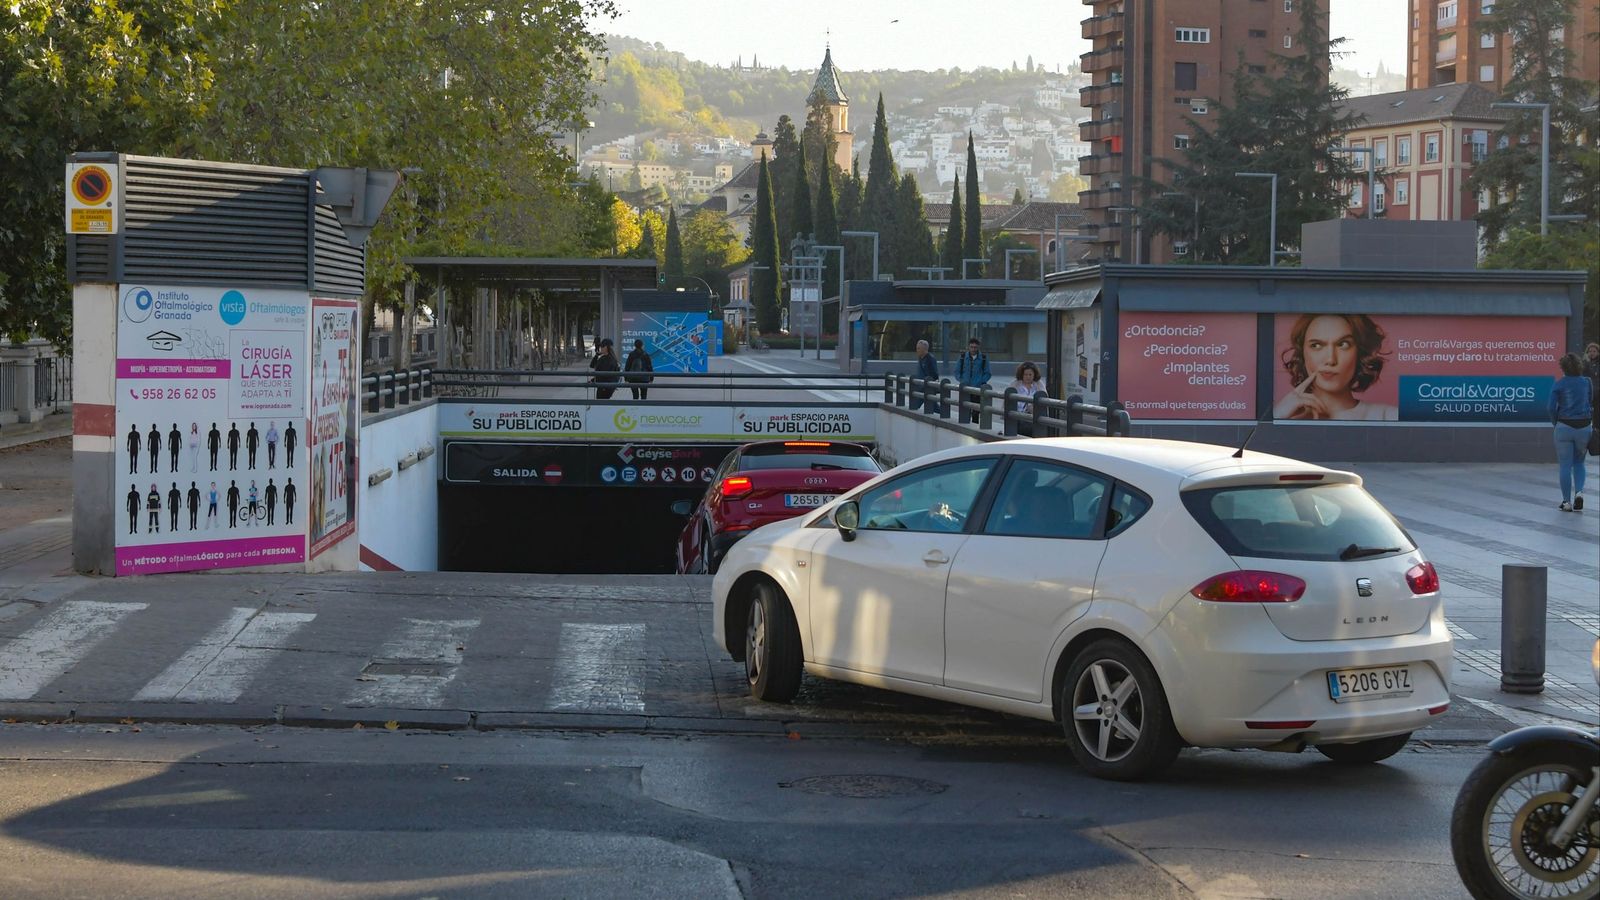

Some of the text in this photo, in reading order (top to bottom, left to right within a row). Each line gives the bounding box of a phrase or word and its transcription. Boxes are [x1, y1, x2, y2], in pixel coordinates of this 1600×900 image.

[157, 291, 189, 300] Instituto
[154, 300, 213, 312] Oftalmológico
[222, 301, 244, 312] vista
[250, 302, 306, 316] Oftalmólogos
[154, 311, 192, 320] Granada
[1125, 325, 1205, 338] ¿Ortodoncia?
[1144, 344, 1228, 357] ¿Periodoncia?
[1398, 340, 1555, 350] En Corral&Vargas queremos que
[242, 345, 292, 359] CIRUGÍA
[1398, 353, 1431, 363] tengas
[1432, 354, 1454, 363] muy
[1457, 353, 1482, 361] claro
[1496, 353, 1555, 362] tratamiento.
[130, 364, 145, 373] MIOPÍA
[241, 360, 292, 379] LÁSER
[1164, 362, 1230, 375] ¿Implantes
[1188, 374, 1247, 385] dentales?
[142, 388, 216, 399] 958 26 62 05
[241, 390, 273, 398] ADAPTA
[1418, 383, 1535, 401] Corral&Vargas
[1125, 401, 1246, 411] Es normal que tengas dudas
[1434, 404, 1518, 413] SALUD DENTAL
[472, 418, 582, 430] SU PUBLICIDAD
[640, 415, 703, 424] newcolor
[744, 422, 851, 434] SU PUBLICIDAD
[636, 449, 701, 460] Geysepark
[493, 468, 538, 477] SALIDA
[683, 470, 694, 478] 10
[793, 496, 819, 504] 2656
[134, 556, 166, 565] MÉTODO
[169, 552, 224, 563] oftalmoLÓGICO
[226, 551, 242, 559] para
[244, 549, 260, 557] cada
[262, 547, 296, 556] PERSONA
[1343, 616, 1389, 624] LEON
[1339, 672, 1379, 693] 5206
[1384, 670, 1410, 689] GYZ
